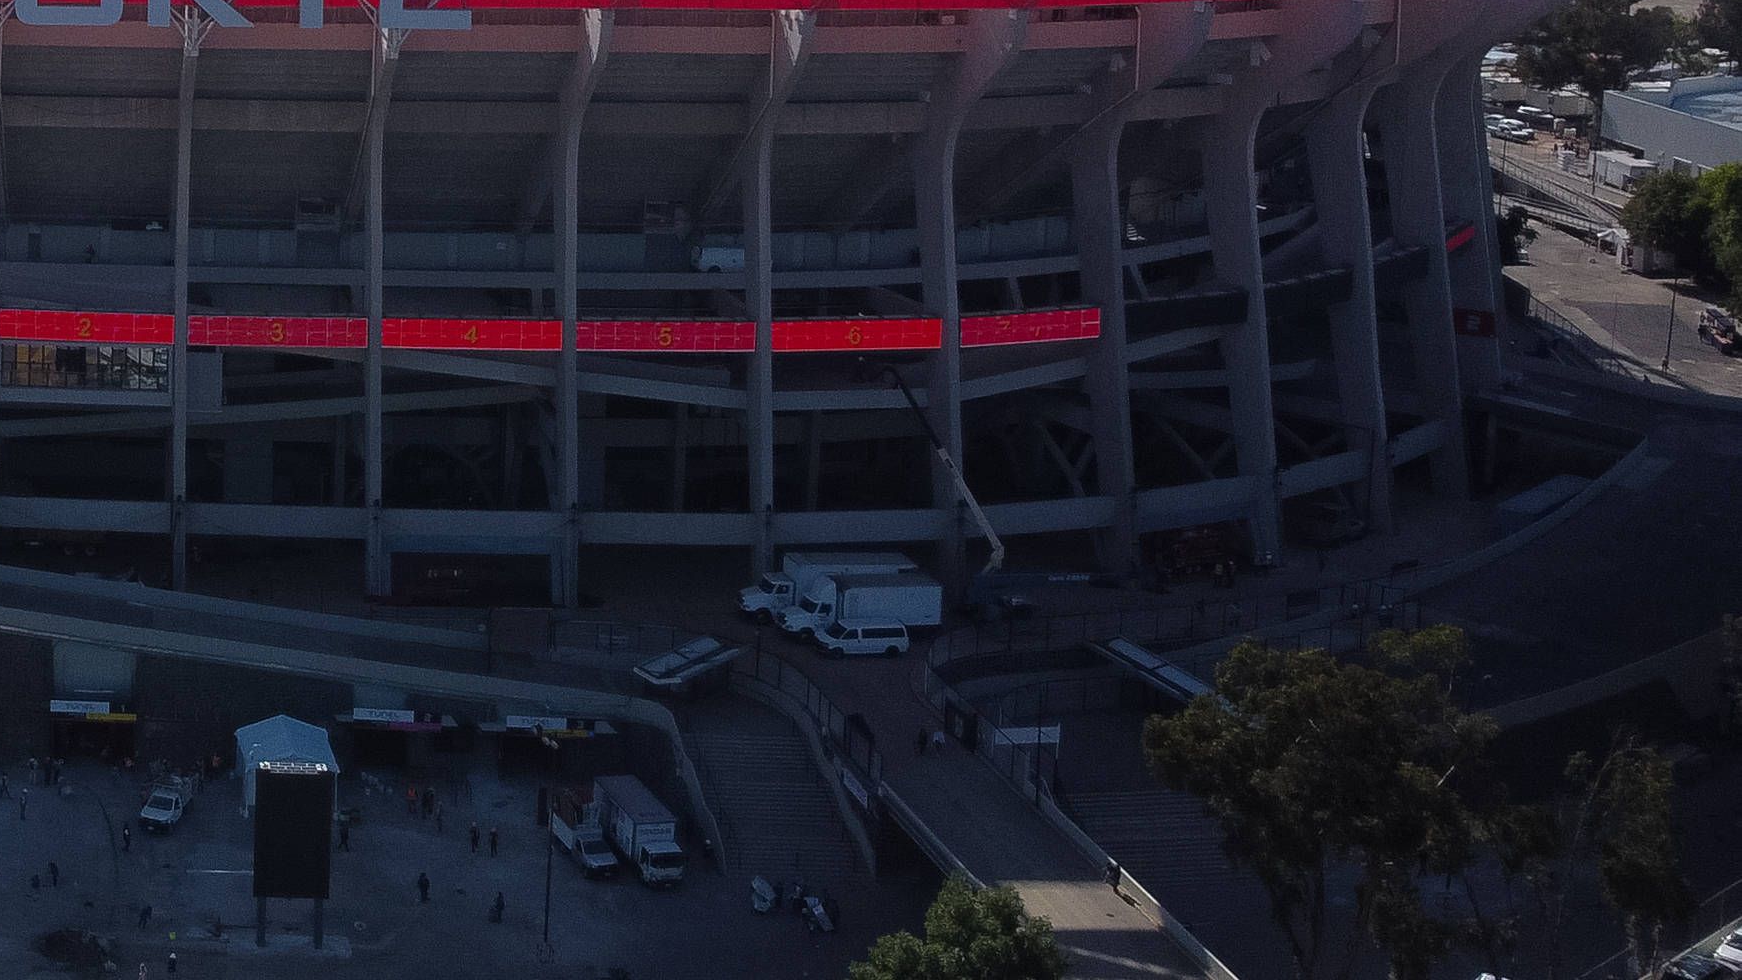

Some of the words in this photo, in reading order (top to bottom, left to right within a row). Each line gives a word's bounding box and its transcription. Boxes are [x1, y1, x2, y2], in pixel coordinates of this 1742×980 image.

[77, 317, 93, 338] 2
[270, 322, 285, 343] 3
[465, 325, 479, 344] 4
[658, 326, 672, 348] 5
[848, 325, 862, 346] 6
